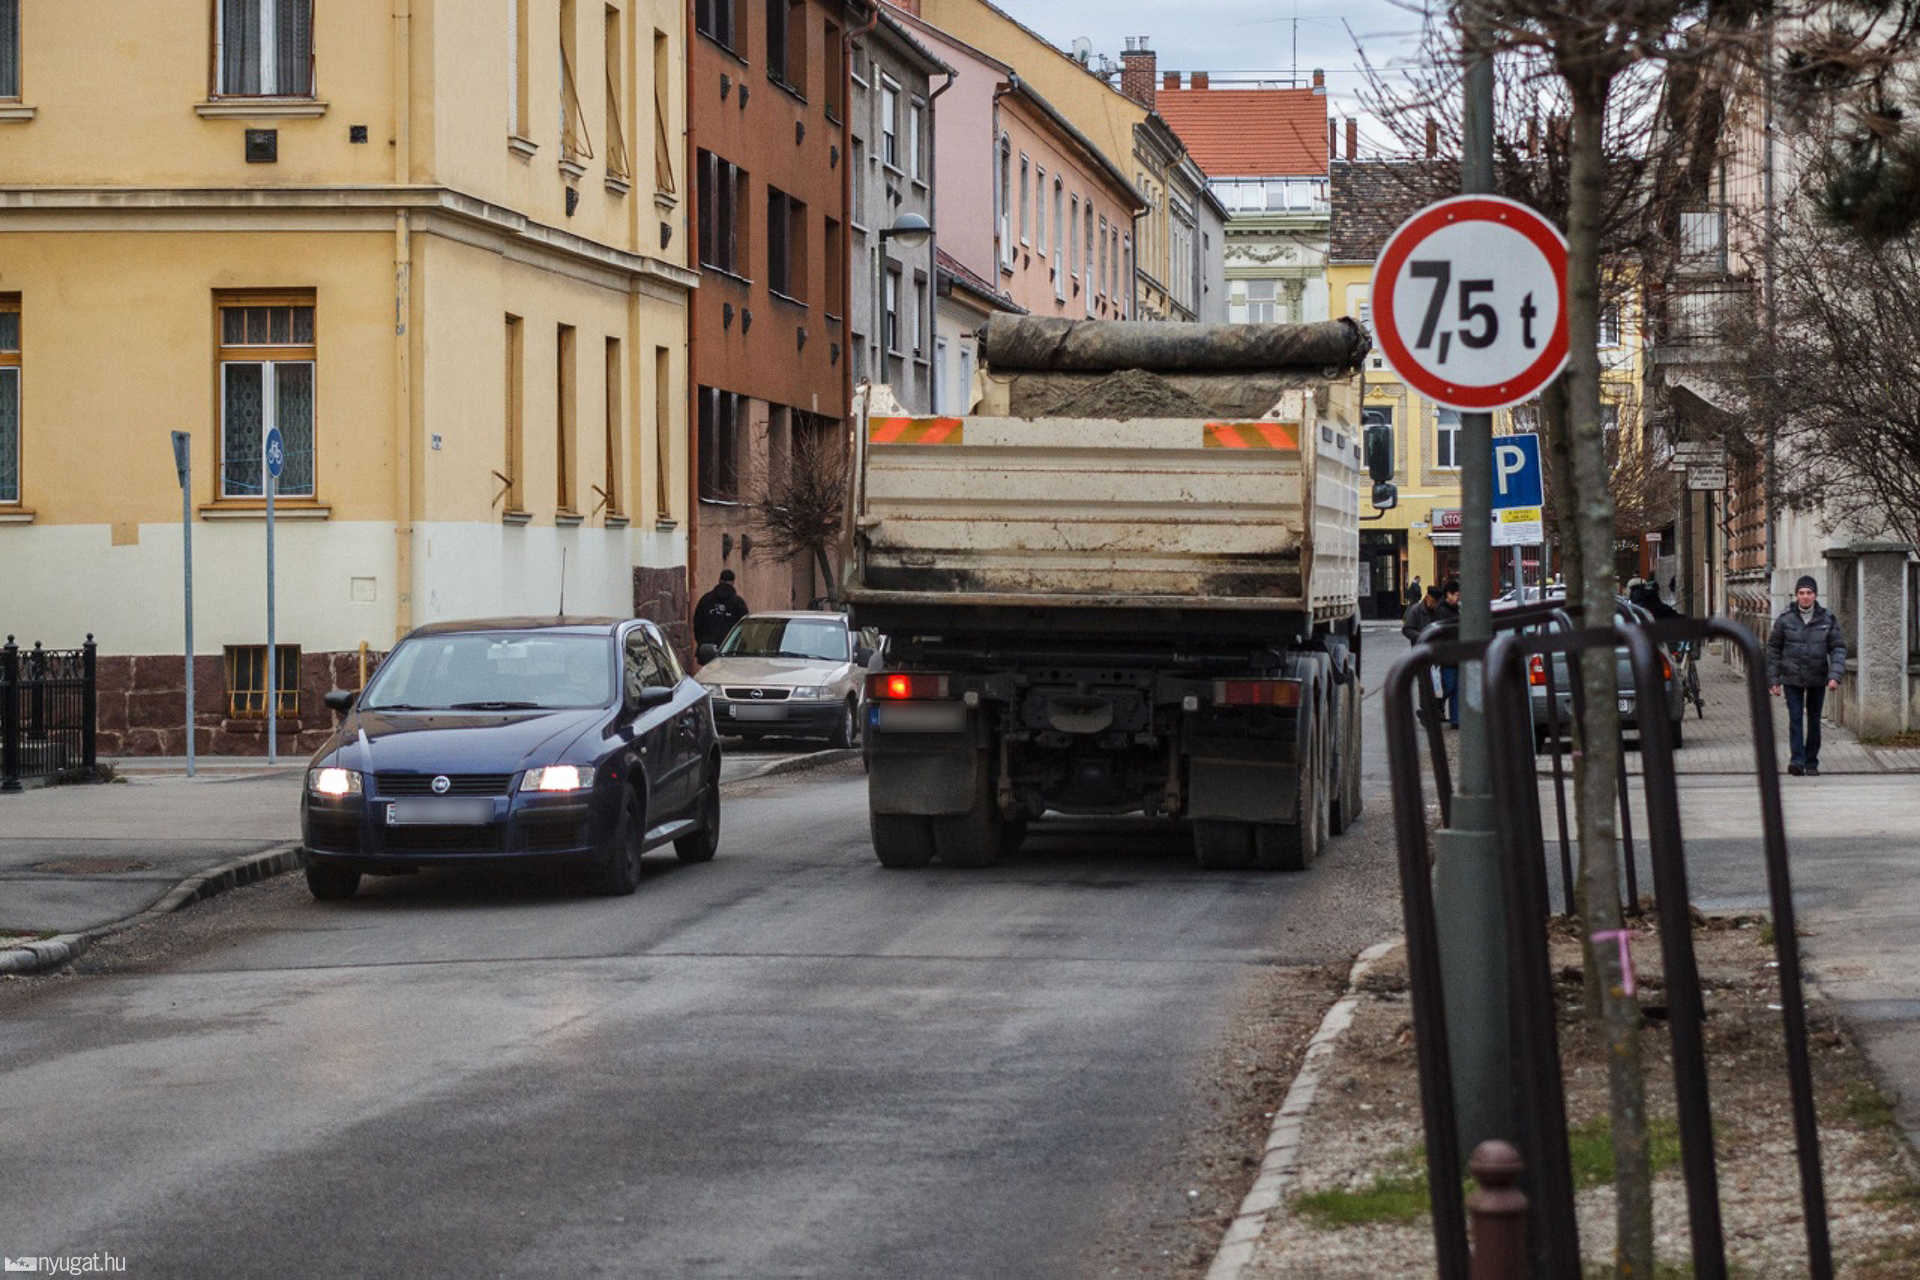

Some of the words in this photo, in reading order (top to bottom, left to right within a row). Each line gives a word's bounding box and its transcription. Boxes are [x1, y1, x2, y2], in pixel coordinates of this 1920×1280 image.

[1410, 261, 1498, 364] 7,5
[1520, 290, 1537, 349] t
[1495, 445, 1526, 494] P
[1442, 513, 1462, 526] STO
